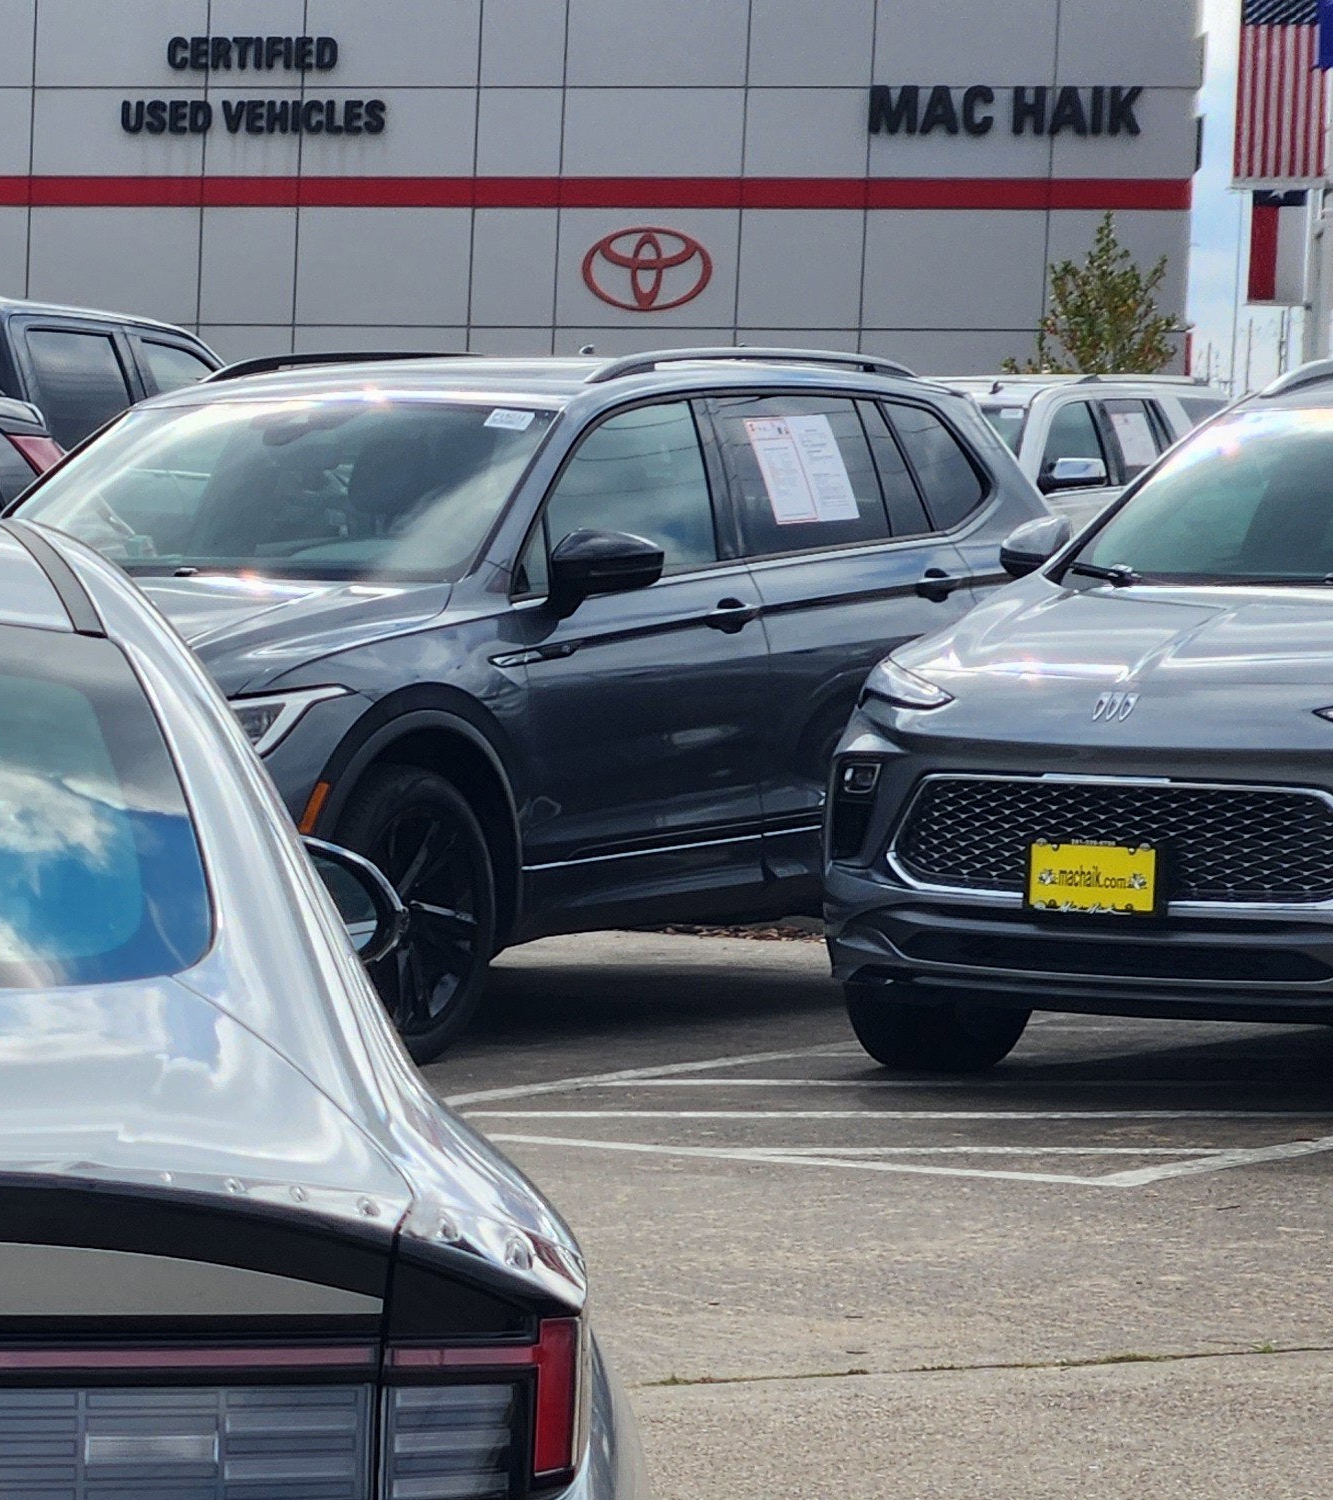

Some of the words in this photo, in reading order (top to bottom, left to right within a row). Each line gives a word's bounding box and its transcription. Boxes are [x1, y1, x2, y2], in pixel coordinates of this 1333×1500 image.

[167, 36, 339, 71] CERTIFIED
[121, 99, 213, 134] USED
[221, 99, 387, 134] VEHICLES
[868, 85, 995, 135] MAC
[1012, 85, 1144, 136] HAIK
